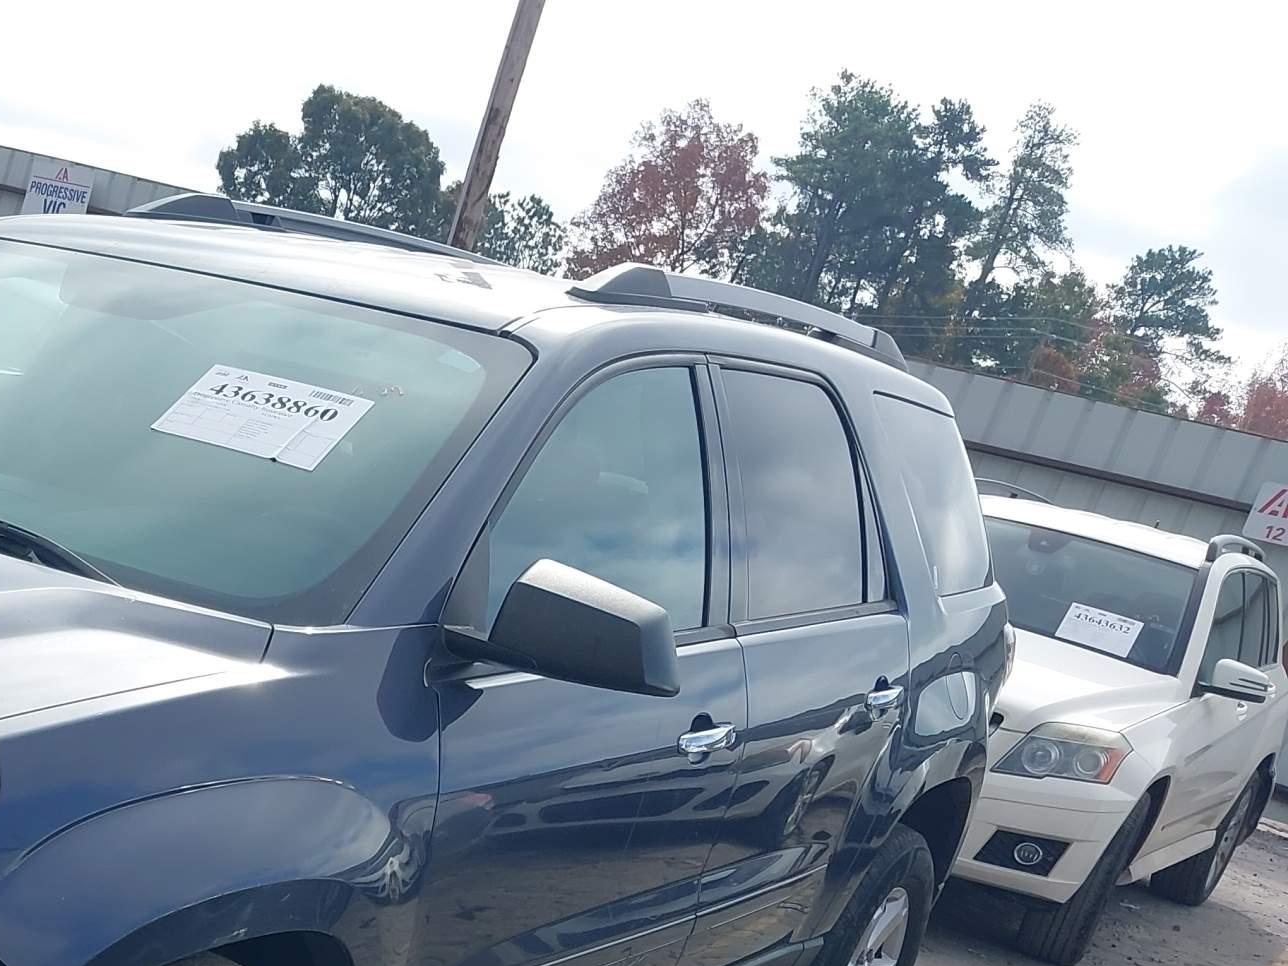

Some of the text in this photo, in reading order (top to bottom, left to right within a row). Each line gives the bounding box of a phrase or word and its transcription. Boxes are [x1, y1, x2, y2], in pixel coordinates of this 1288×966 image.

[29, 181, 88, 204] PROGRESSIVE
[209, 383, 339, 422] 43638860
[1265, 525, 1286, 541] 12
